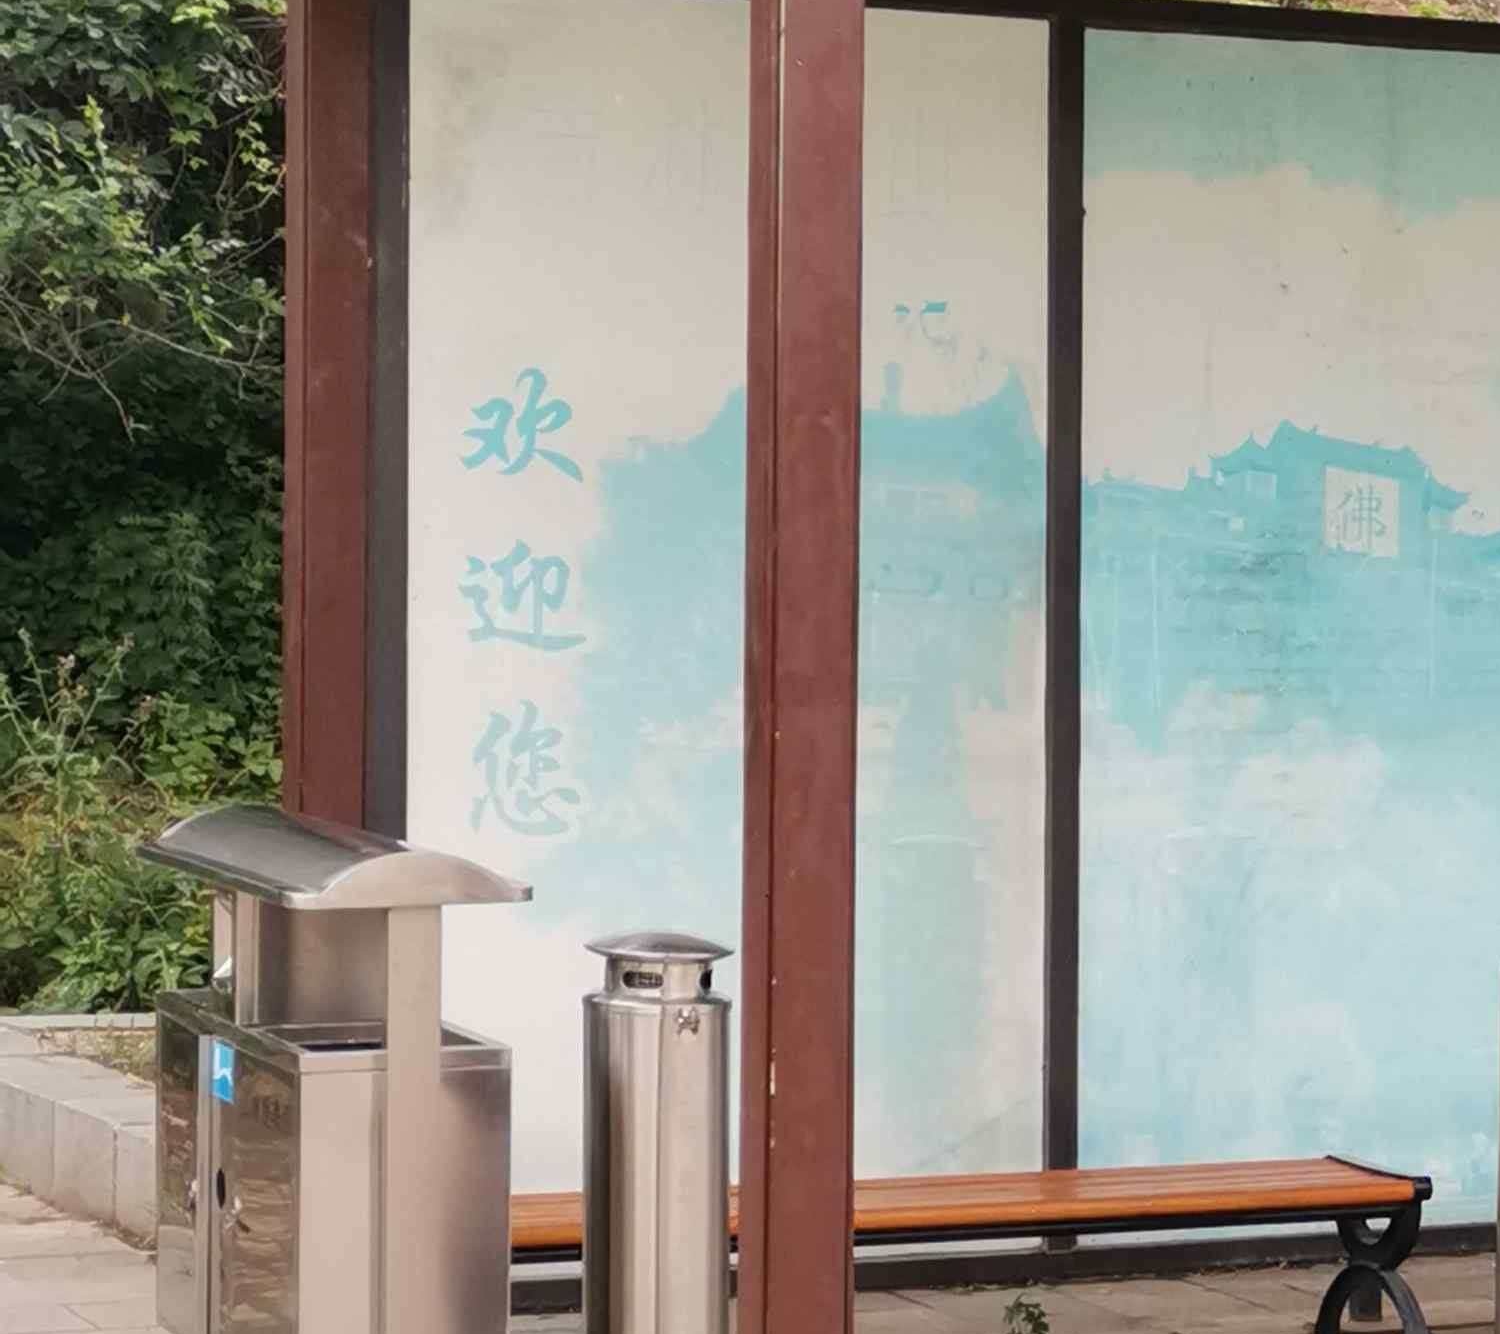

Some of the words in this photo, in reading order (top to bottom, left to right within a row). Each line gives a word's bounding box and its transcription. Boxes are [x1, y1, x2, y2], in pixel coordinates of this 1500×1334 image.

[458, 367, 587, 836] 欢迎您
[1336, 483, 1387, 551] 佛
